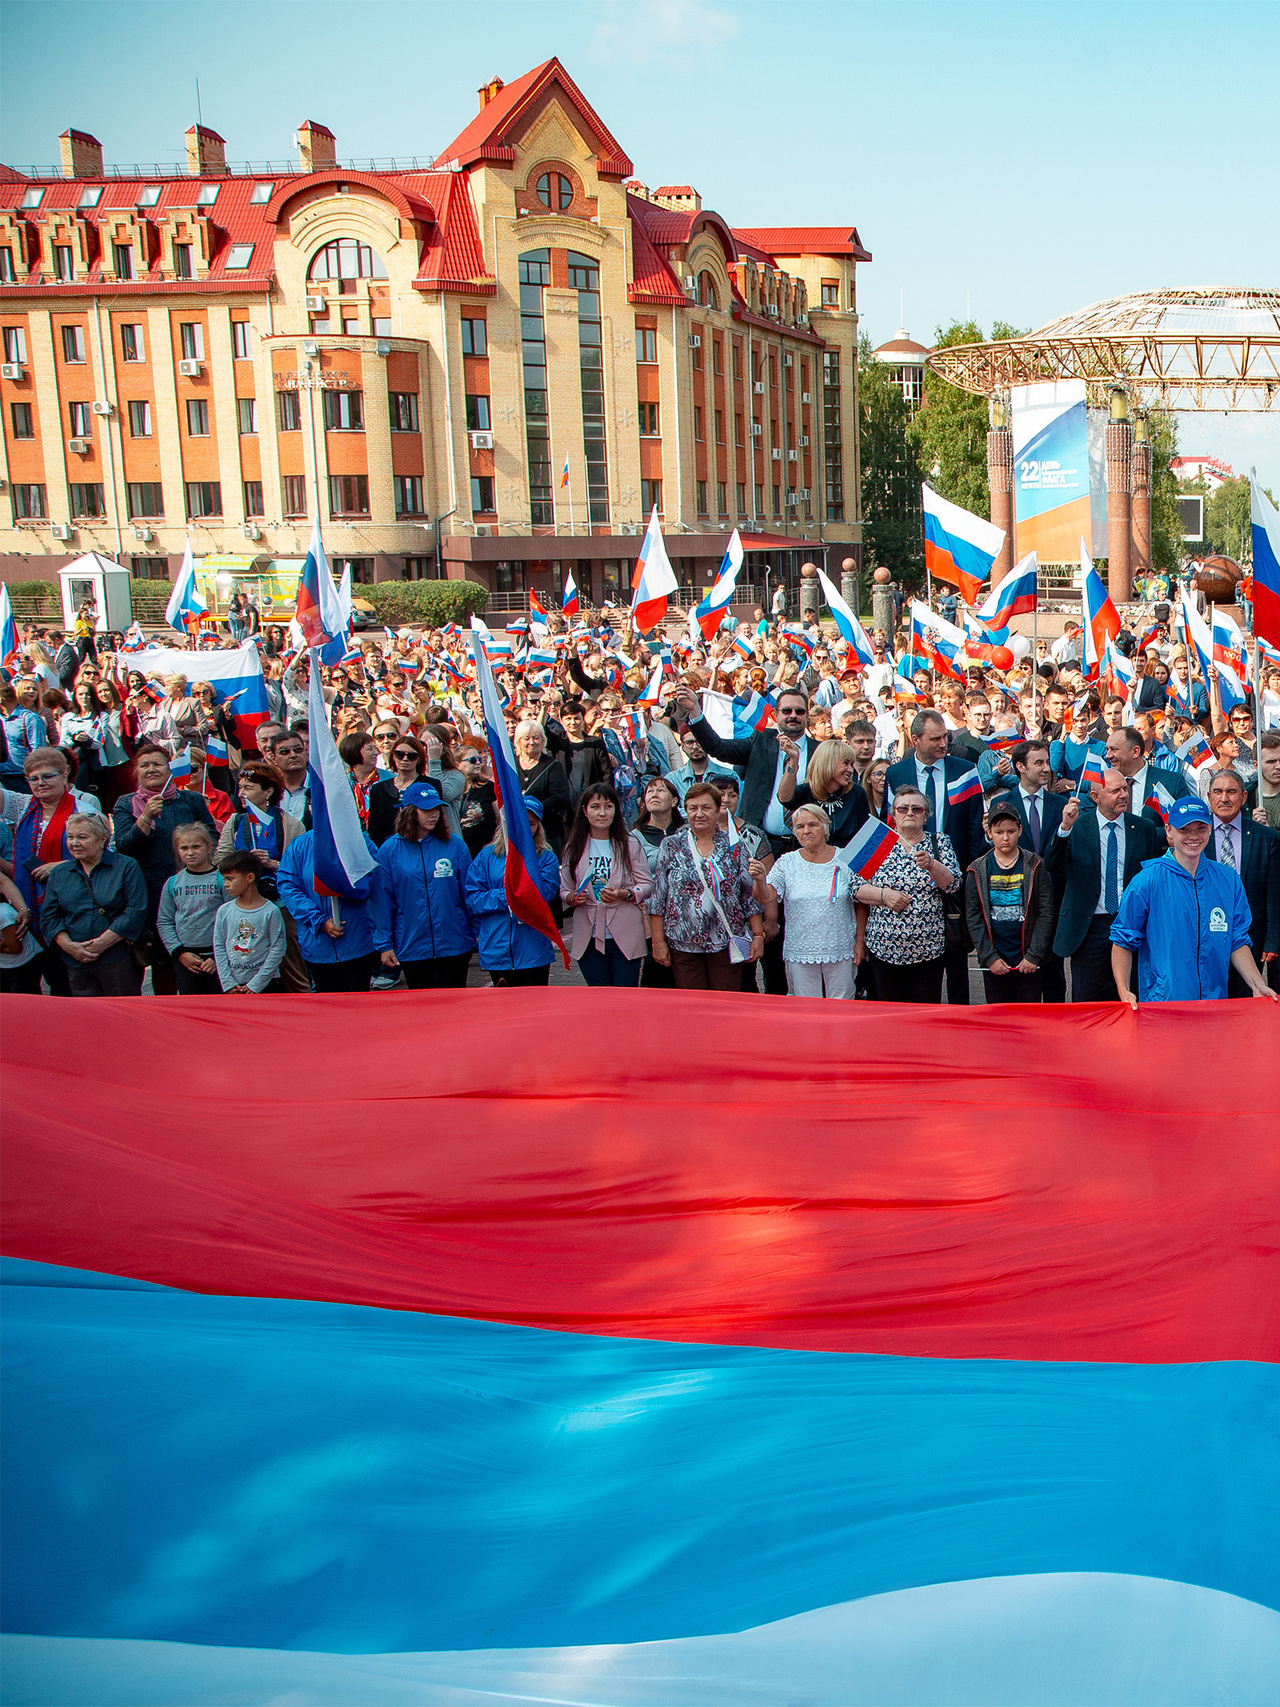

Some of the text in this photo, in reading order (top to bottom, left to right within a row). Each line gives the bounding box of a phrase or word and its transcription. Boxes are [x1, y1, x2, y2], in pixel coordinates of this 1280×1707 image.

[1021, 461, 1038, 481] 22
[1222, 649, 1242, 663] РОСС
[184, 884, 219, 896] BOYFRIEN
